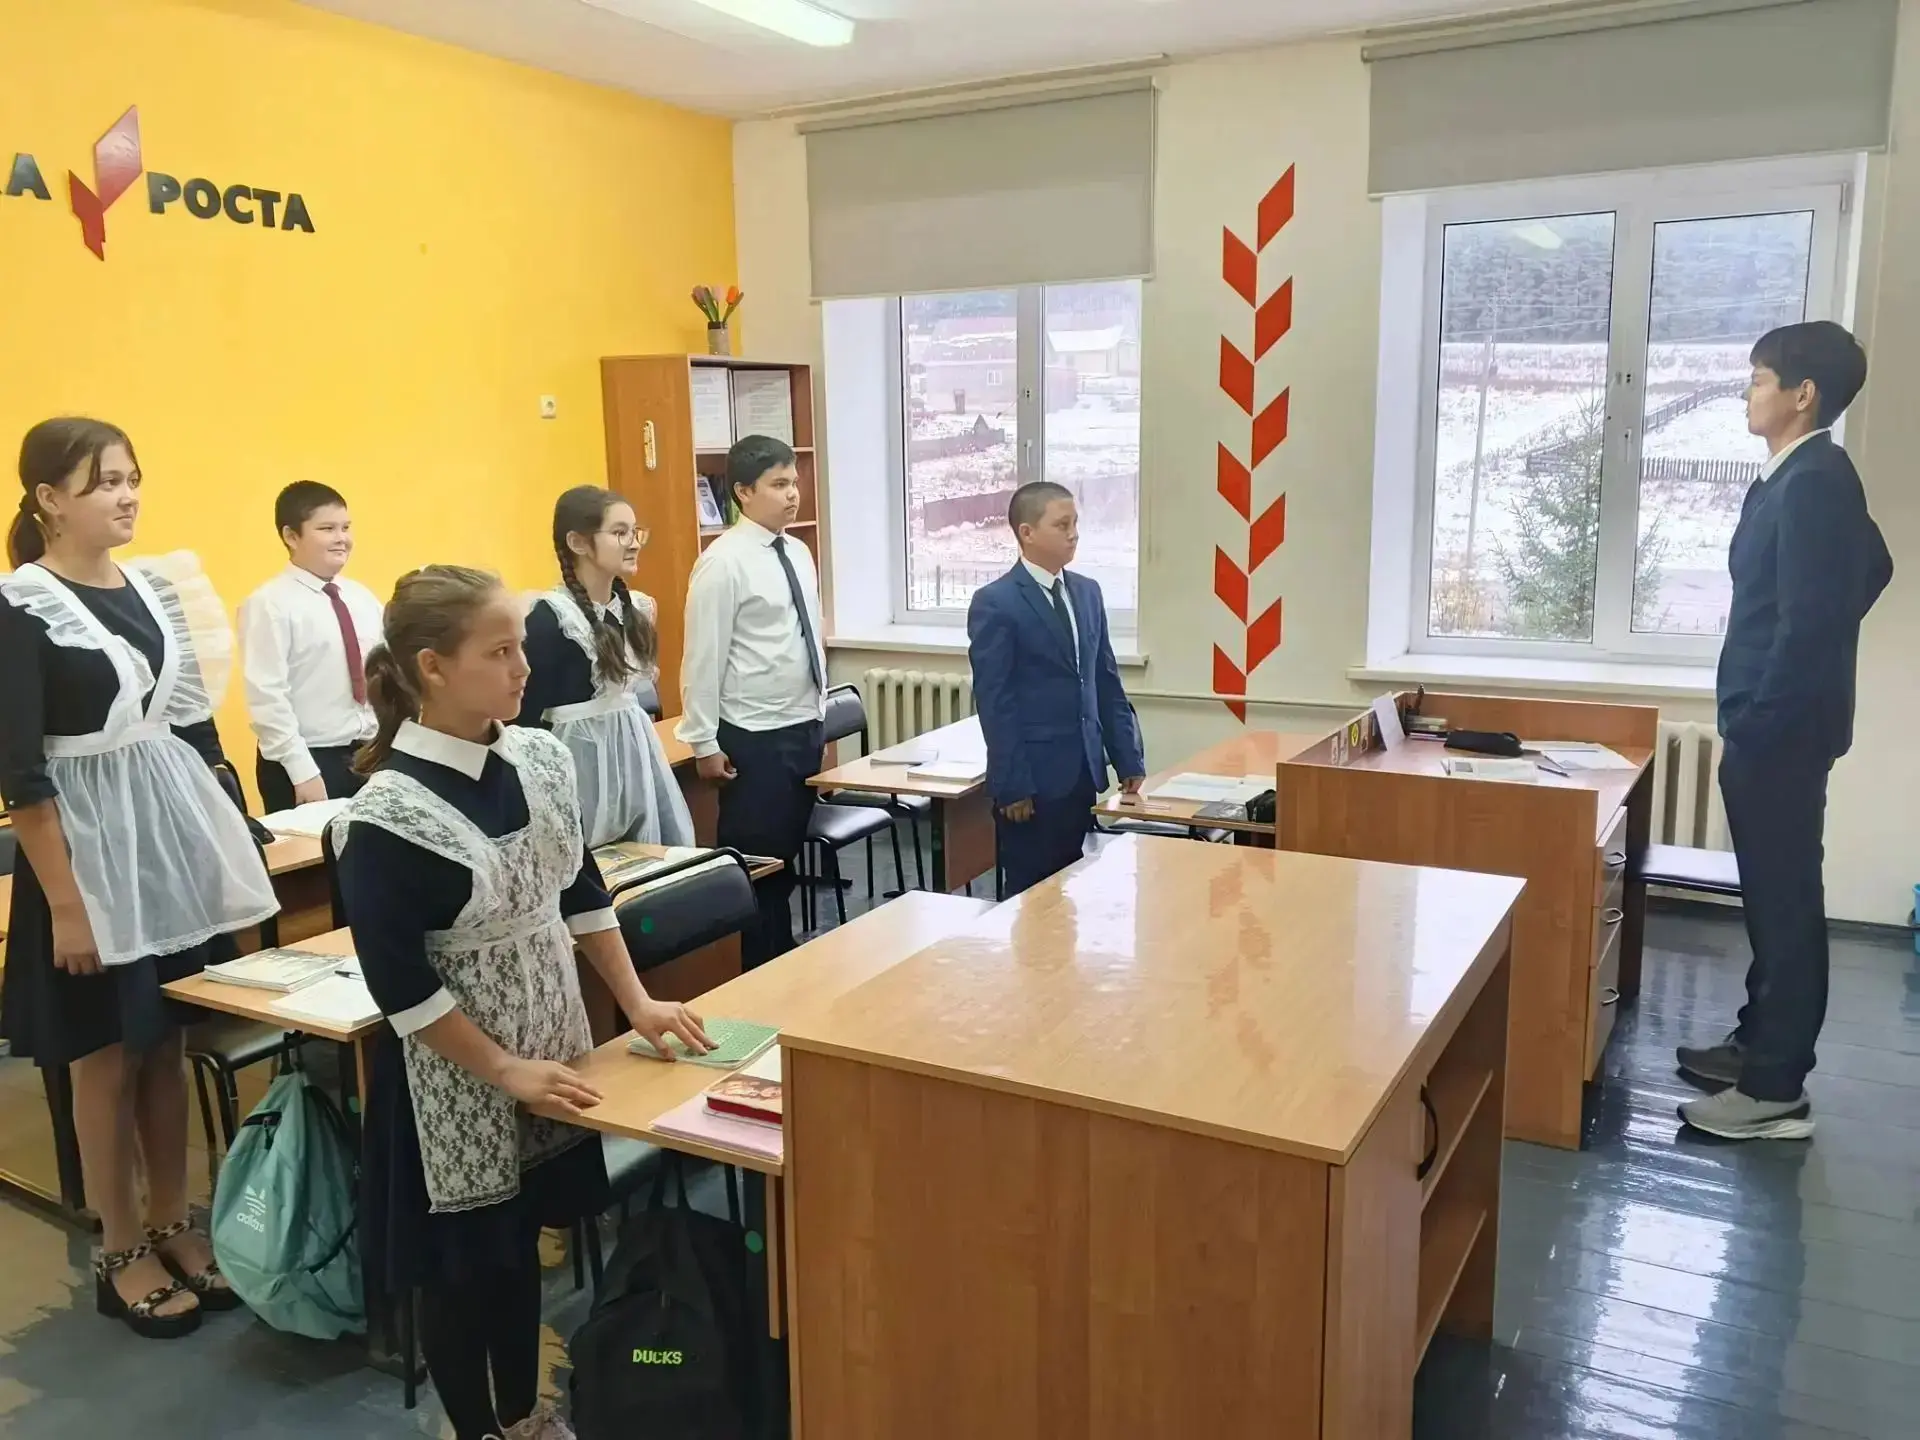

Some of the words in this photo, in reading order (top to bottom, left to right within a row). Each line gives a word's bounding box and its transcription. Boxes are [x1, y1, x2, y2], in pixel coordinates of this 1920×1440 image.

[0, 152, 52, 200] А
[146, 171, 315, 233] РОСТА
[236, 1212, 265, 1233] adidas
[632, 1348, 683, 1365] DUCKS
